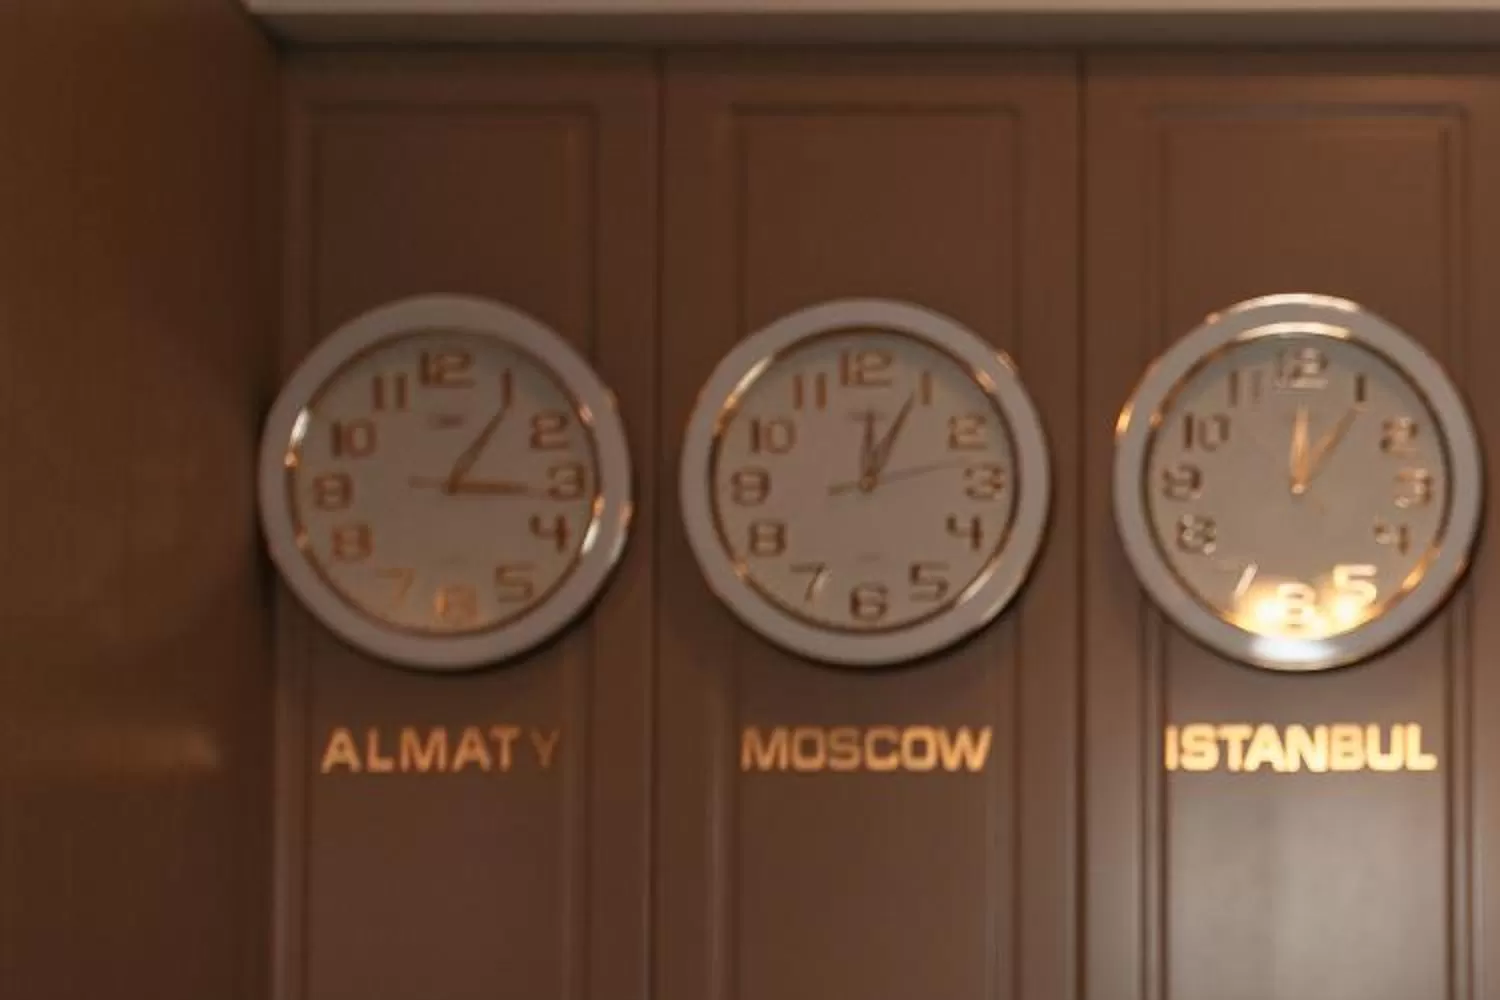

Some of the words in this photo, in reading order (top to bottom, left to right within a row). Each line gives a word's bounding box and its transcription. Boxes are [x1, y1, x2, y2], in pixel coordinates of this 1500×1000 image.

[417, 347, 476, 388] 12
[839, 350, 894, 388] 12
[373, 374, 409, 412] 11
[502, 368, 513, 410] 1
[792, 374, 827, 411] 11
[921, 371, 932, 405] 1
[1229, 372, 1261, 406] 11
[1355, 374, 1365, 403] 1
[331, 419, 376, 459] 10
[530, 411, 570, 451] 2
[750, 418, 795, 454] 10
[948, 415, 988, 451] 2
[1184, 413, 1230, 451] 10
[548, 462, 585, 498] 3
[731, 468, 769, 506] 9
[965, 464, 1004, 499] 3
[529, 515, 568, 552] 4
[749, 520, 786, 557] 8
[947, 513, 982, 551] 4
[496, 563, 533, 602] 5
[791, 562, 831, 601] 7
[910, 561, 949, 600] 5
[1333, 565, 1377, 603] 5
[850, 583, 887, 621] 6
[320, 727, 561, 773] ALMATY
[740, 726, 993, 772] MOSCOW
[1164, 723, 1438, 772] ISTANBUL
